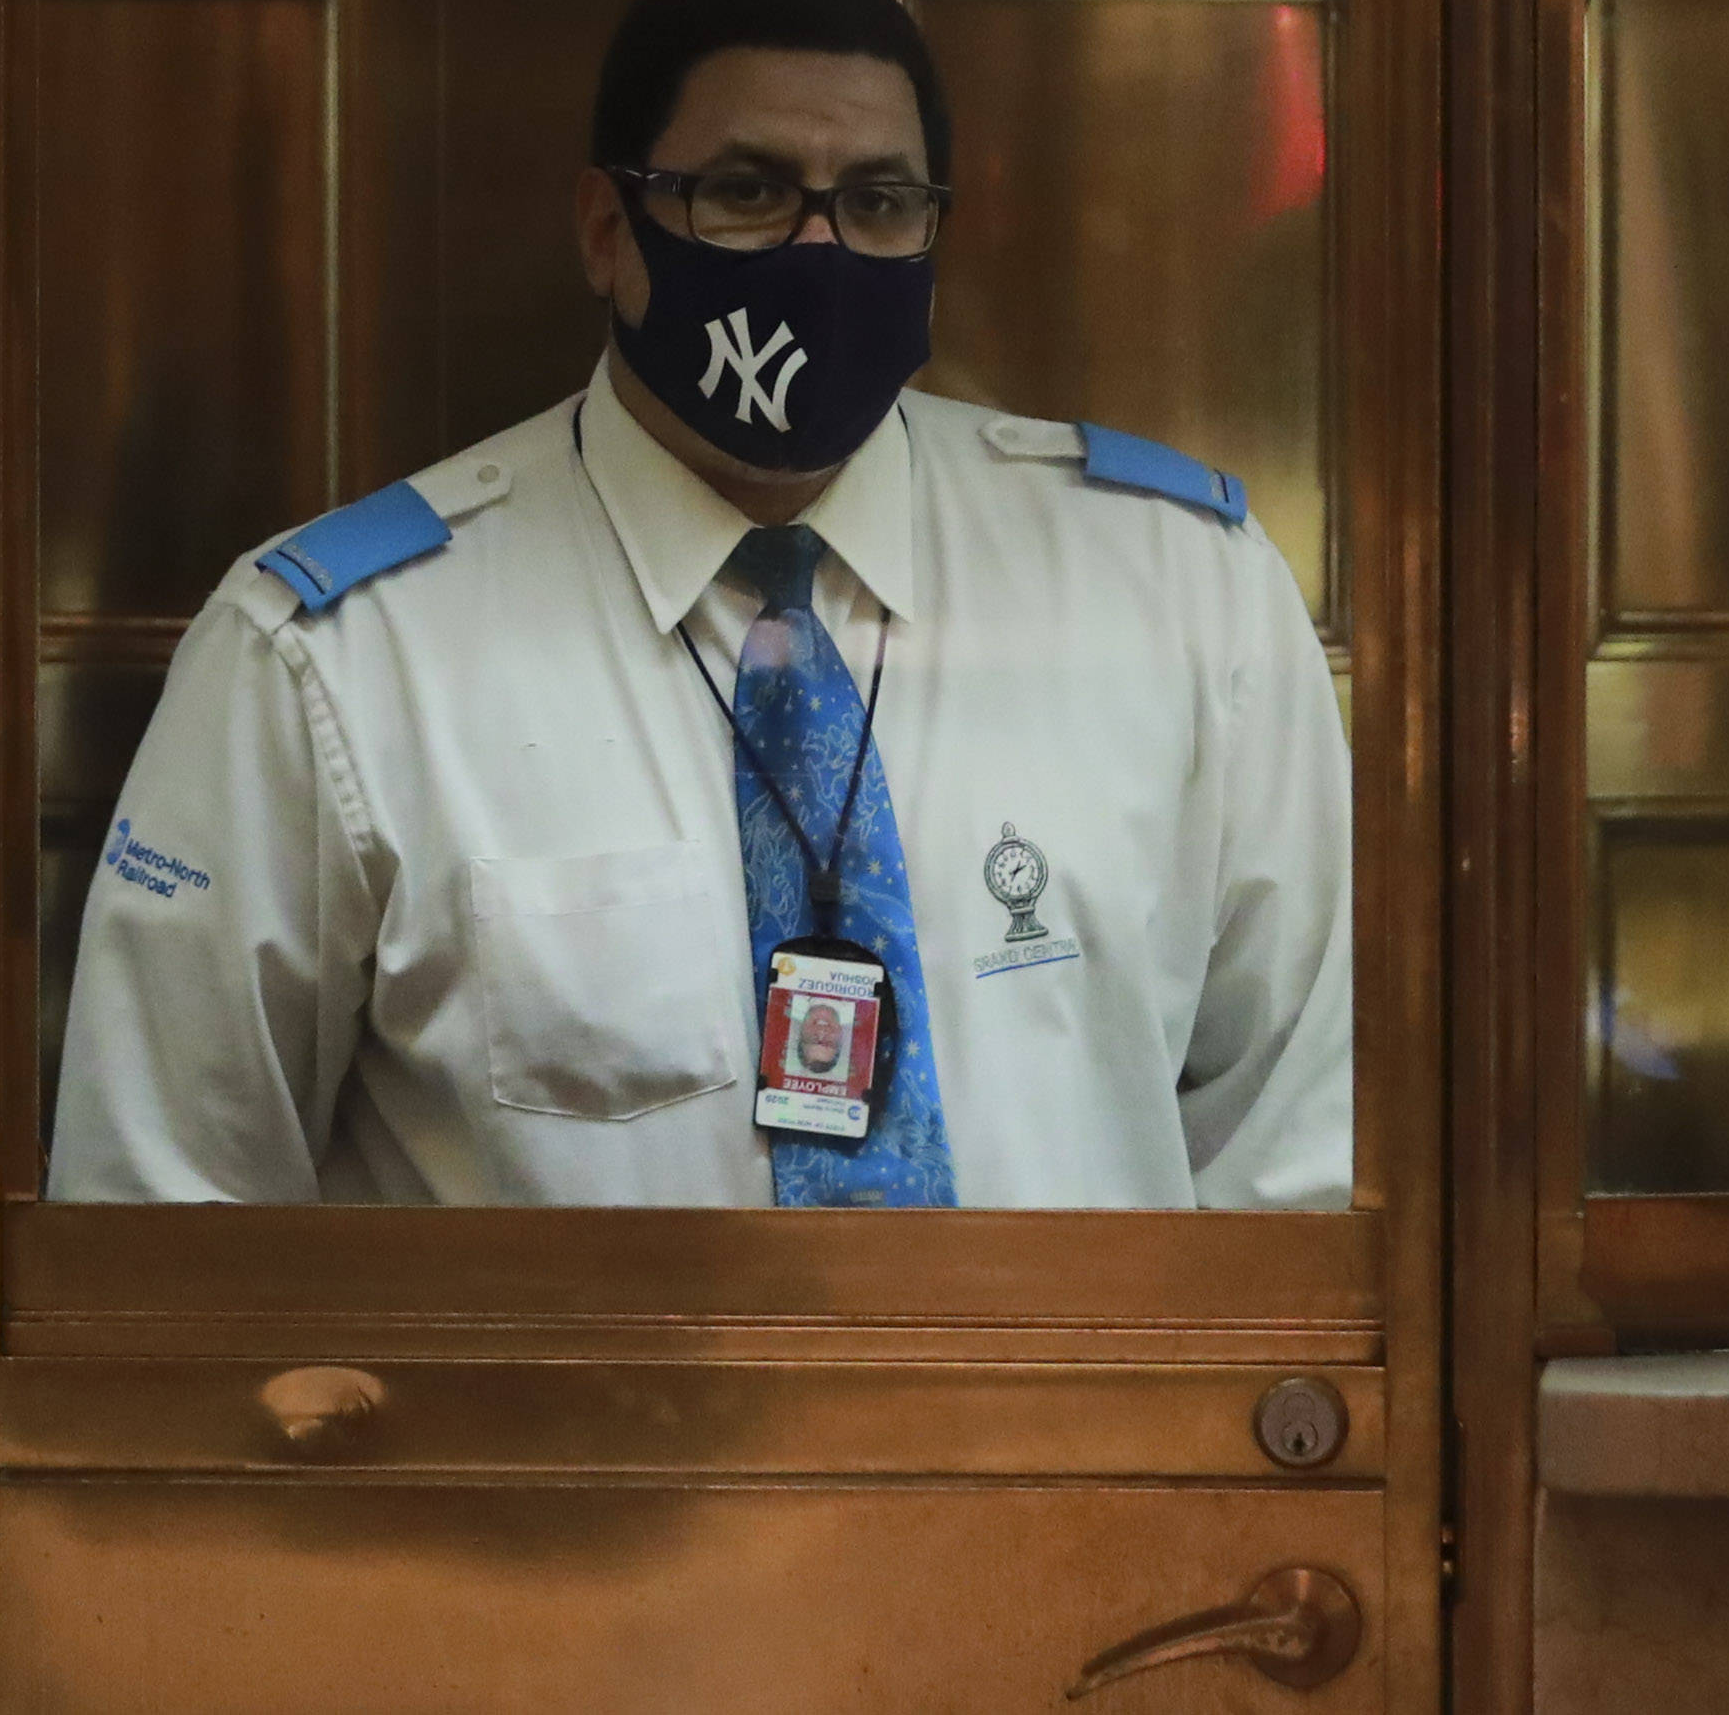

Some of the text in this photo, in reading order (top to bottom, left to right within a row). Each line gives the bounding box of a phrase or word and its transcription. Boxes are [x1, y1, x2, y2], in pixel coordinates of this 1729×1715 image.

[697, 306, 809, 433] NY
[116, 859, 177, 898] Railroad
[125, 838, 211, 890] Metro-North
[782, 1077, 848, 1096] EMPLOYEE
